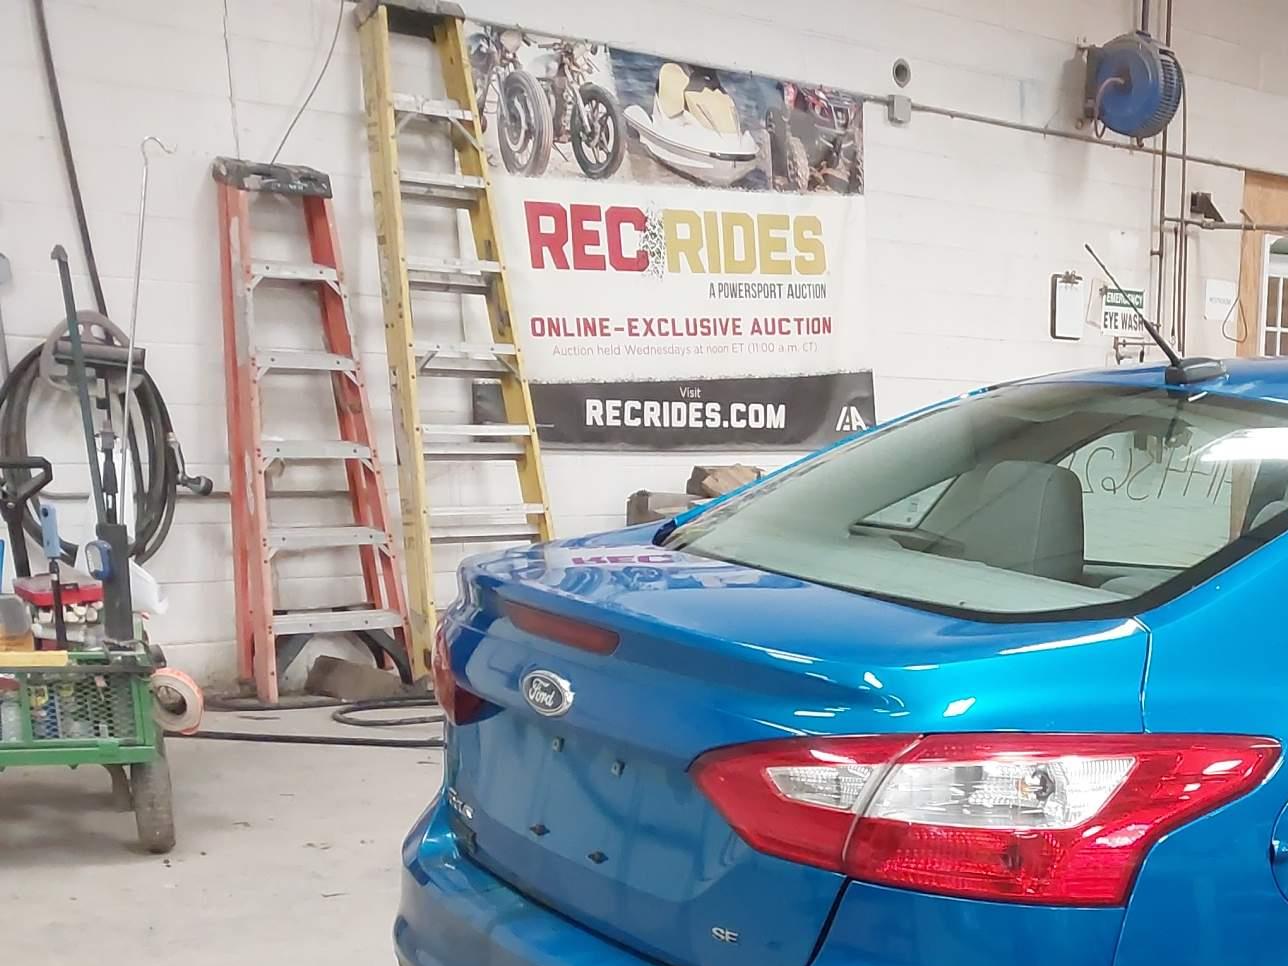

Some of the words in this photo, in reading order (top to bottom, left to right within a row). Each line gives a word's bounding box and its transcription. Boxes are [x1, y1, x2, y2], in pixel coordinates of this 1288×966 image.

[524, 201, 650, 272] REC
[662, 208, 827, 275] RIDES
[709, 282, 716, 299] A
[718, 283, 784, 300] POWERSPORT
[787, 283, 827, 300] AUCTION
[530, 317, 743, 337] ONLINE-EXCLUSIVE
[750, 316, 832, 336] AUCTION
[1103, 311, 1119, 330] EYE
[552, 344, 594, 356] Auction
[597, 344, 621, 356] held
[624, 343, 691, 358] Wednesdays
[693, 345, 704, 354] at
[706, 343, 729, 354] noon
[731, 342, 744, 353] ET
[680, 386, 702, 399] Visit
[584, 398, 787, 430] RECRIDES.COM
[711, 927, 739, 944] SE
